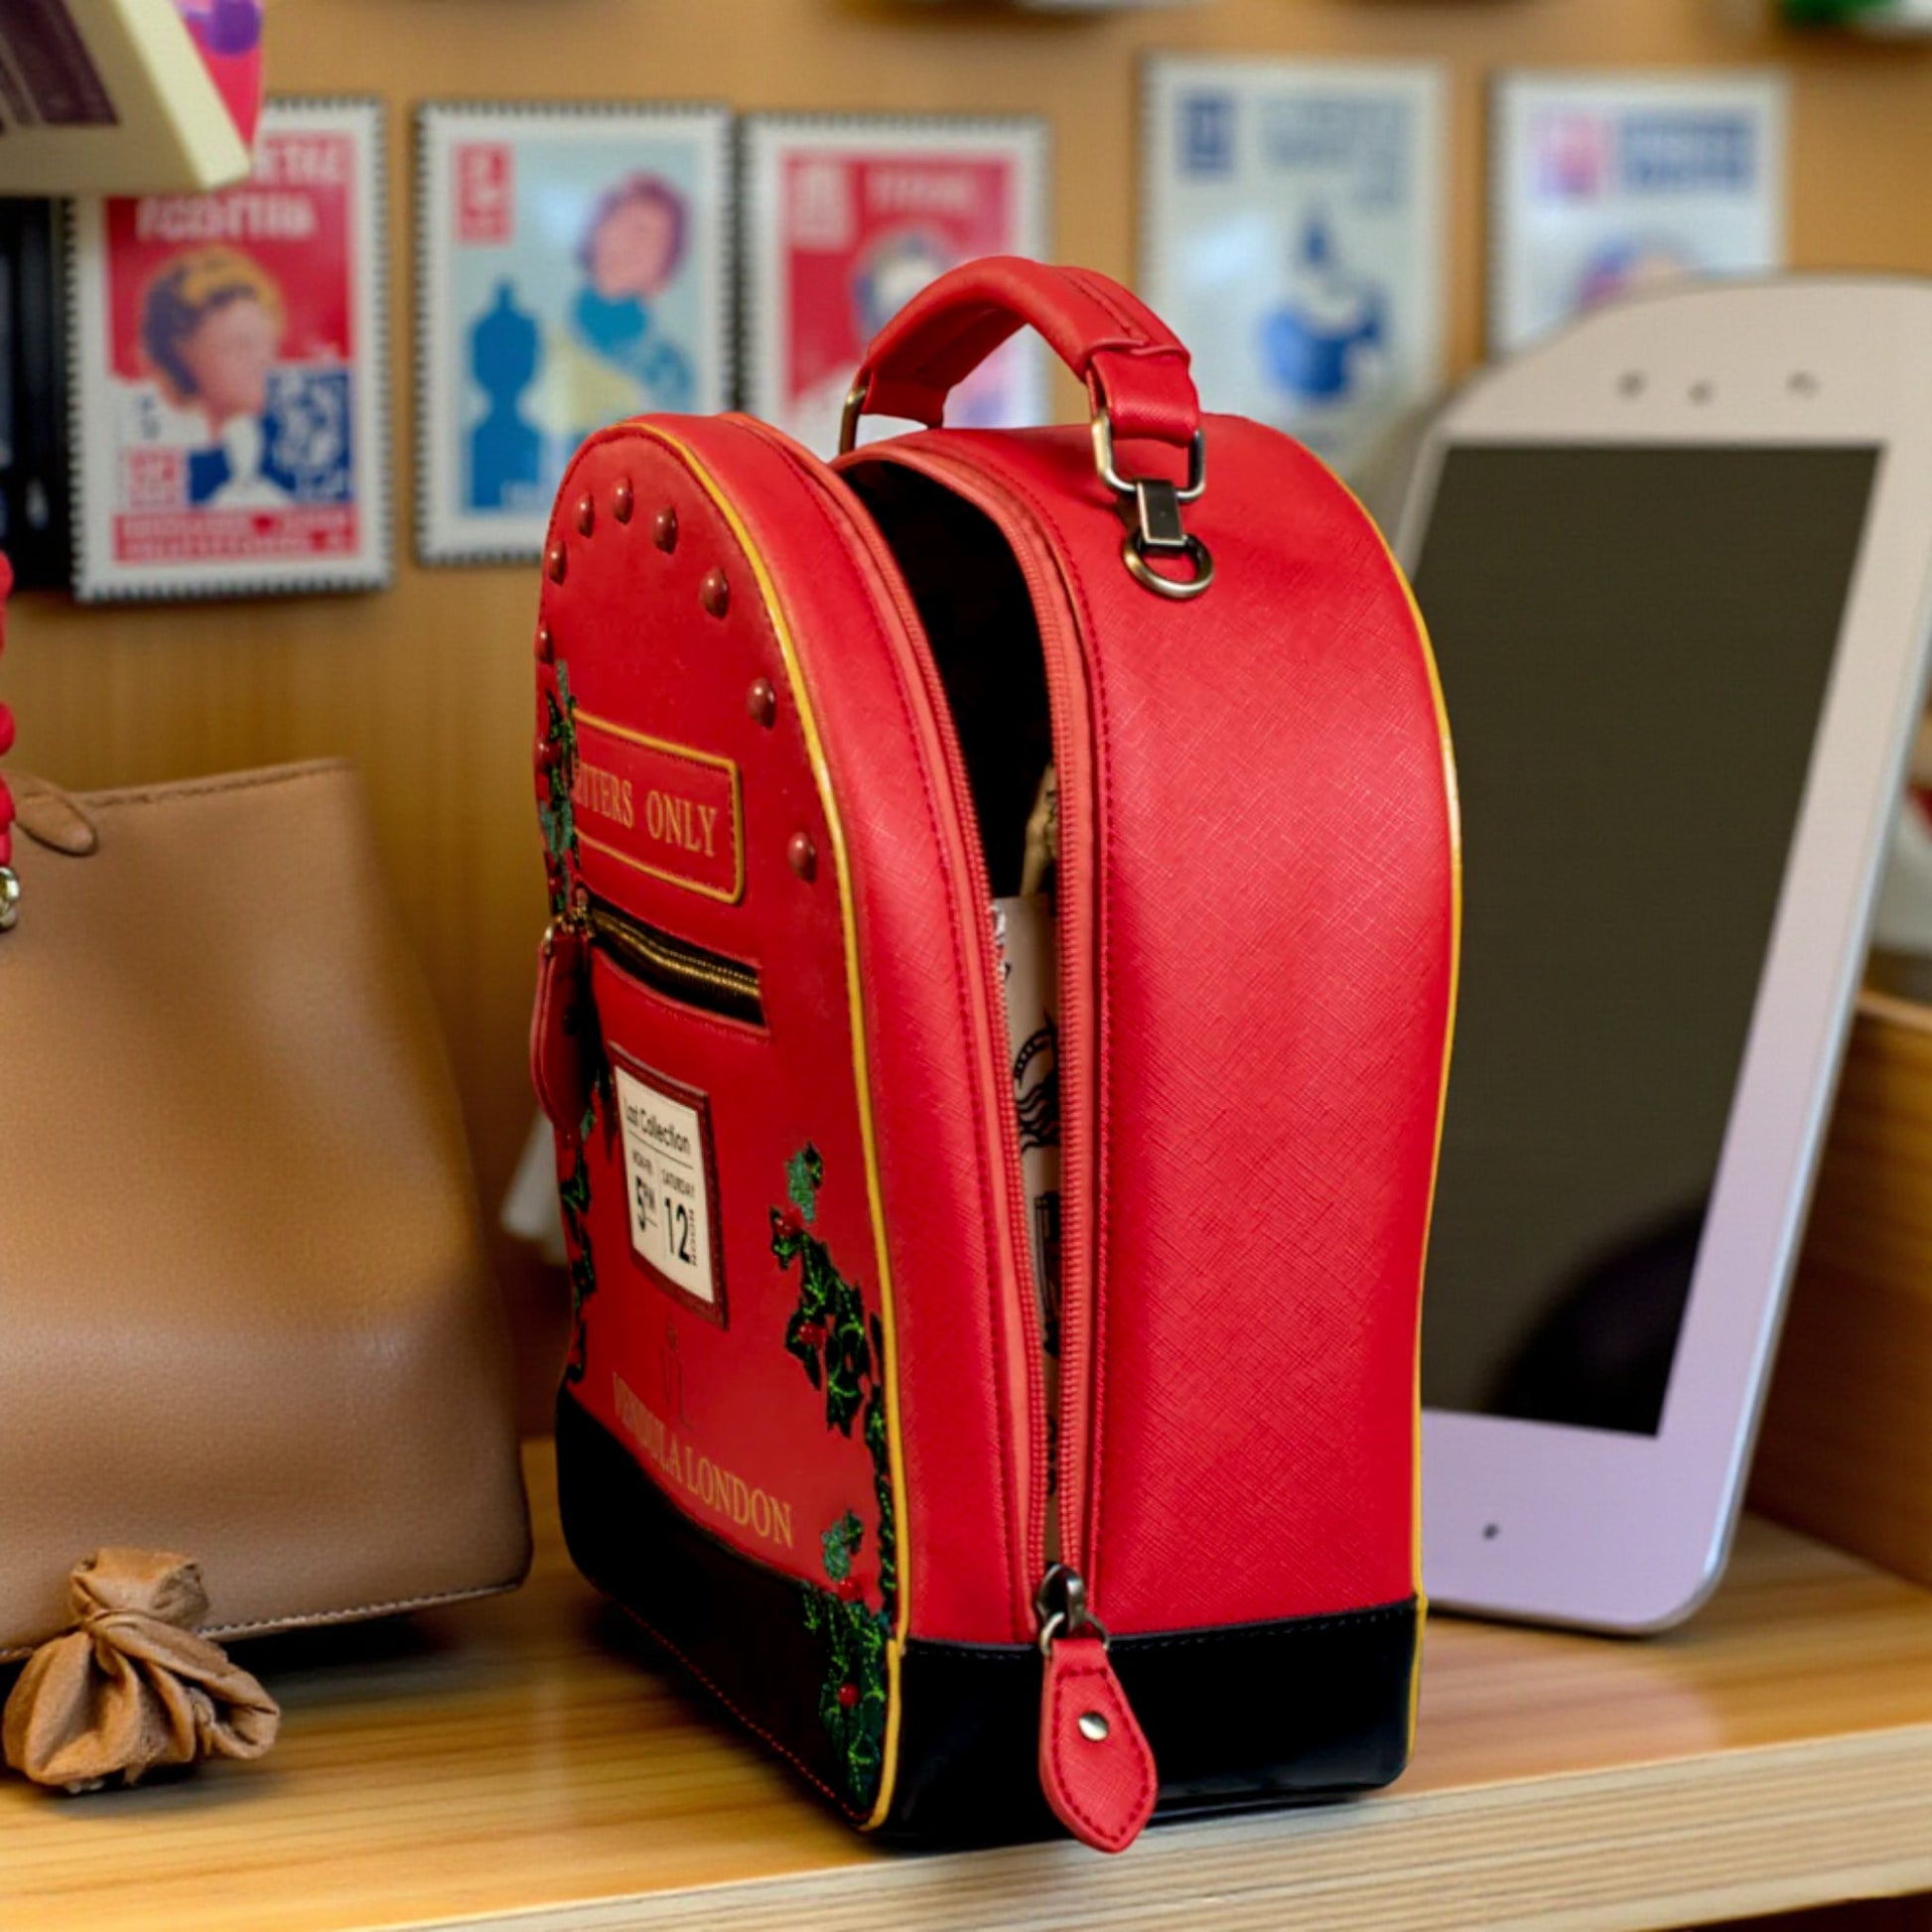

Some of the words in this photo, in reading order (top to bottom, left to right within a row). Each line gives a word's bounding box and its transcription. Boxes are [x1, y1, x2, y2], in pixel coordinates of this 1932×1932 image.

[572, 762, 633, 829] TTERS
[644, 789, 718, 858] ONLY
[640, 1107, 692, 1157] Collection
[664, 1197, 691, 1264] 12
[684, 1445, 794, 1550] LONDON
